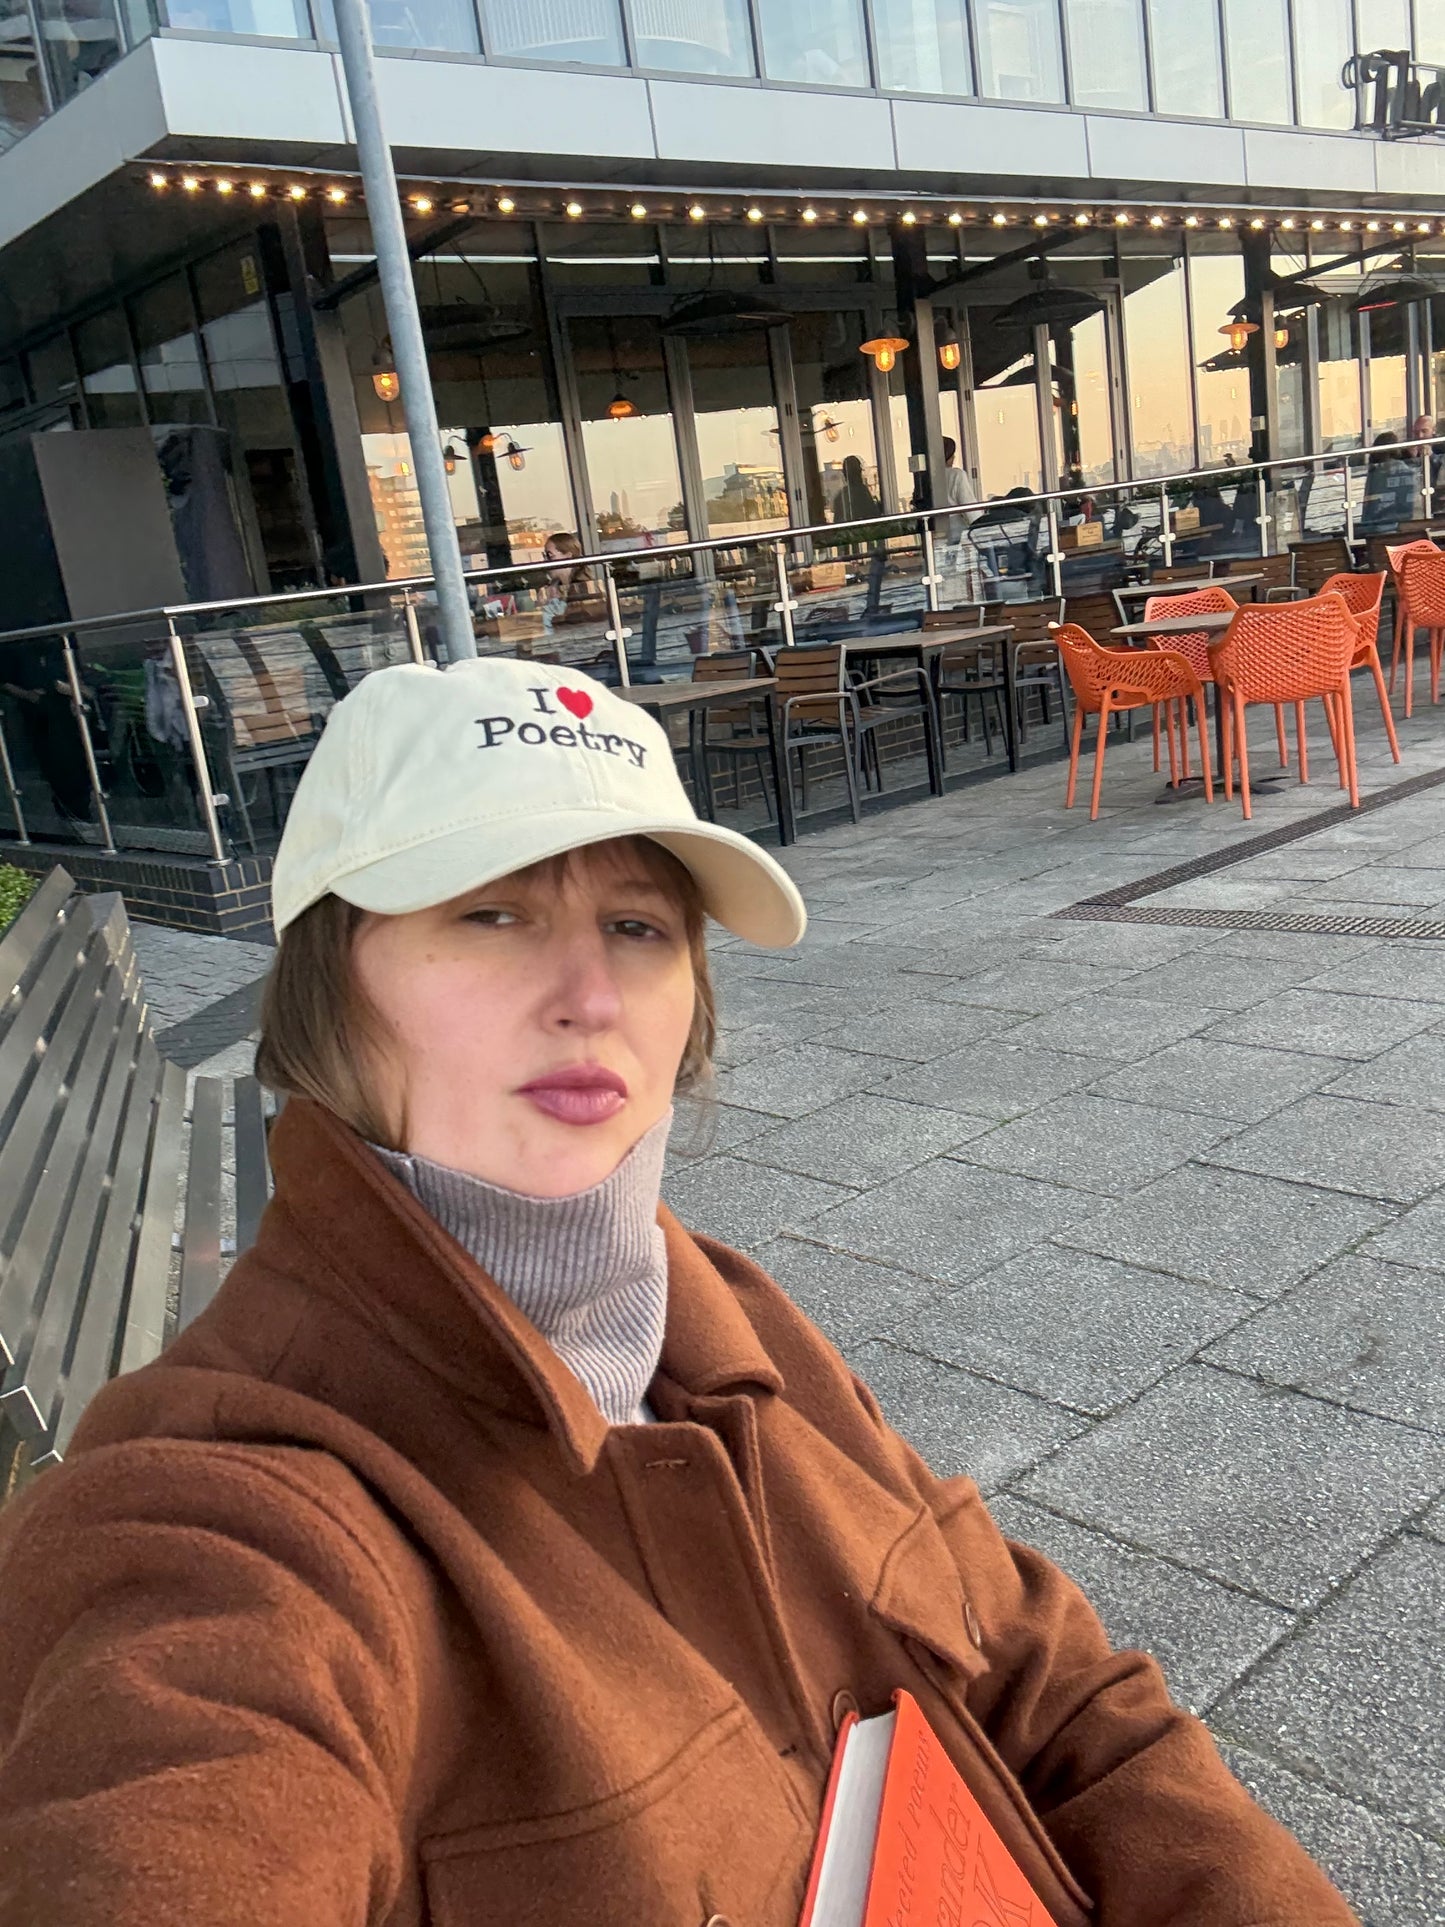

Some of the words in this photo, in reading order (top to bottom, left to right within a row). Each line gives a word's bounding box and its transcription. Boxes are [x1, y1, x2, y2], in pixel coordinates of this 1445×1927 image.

[474, 716, 647, 768] Poetry
[527, 687, 557, 714] I
[886, 1821, 918, 1927] ected
[906, 1729, 931, 1829] poems
[929, 1782, 971, 1927] ander
